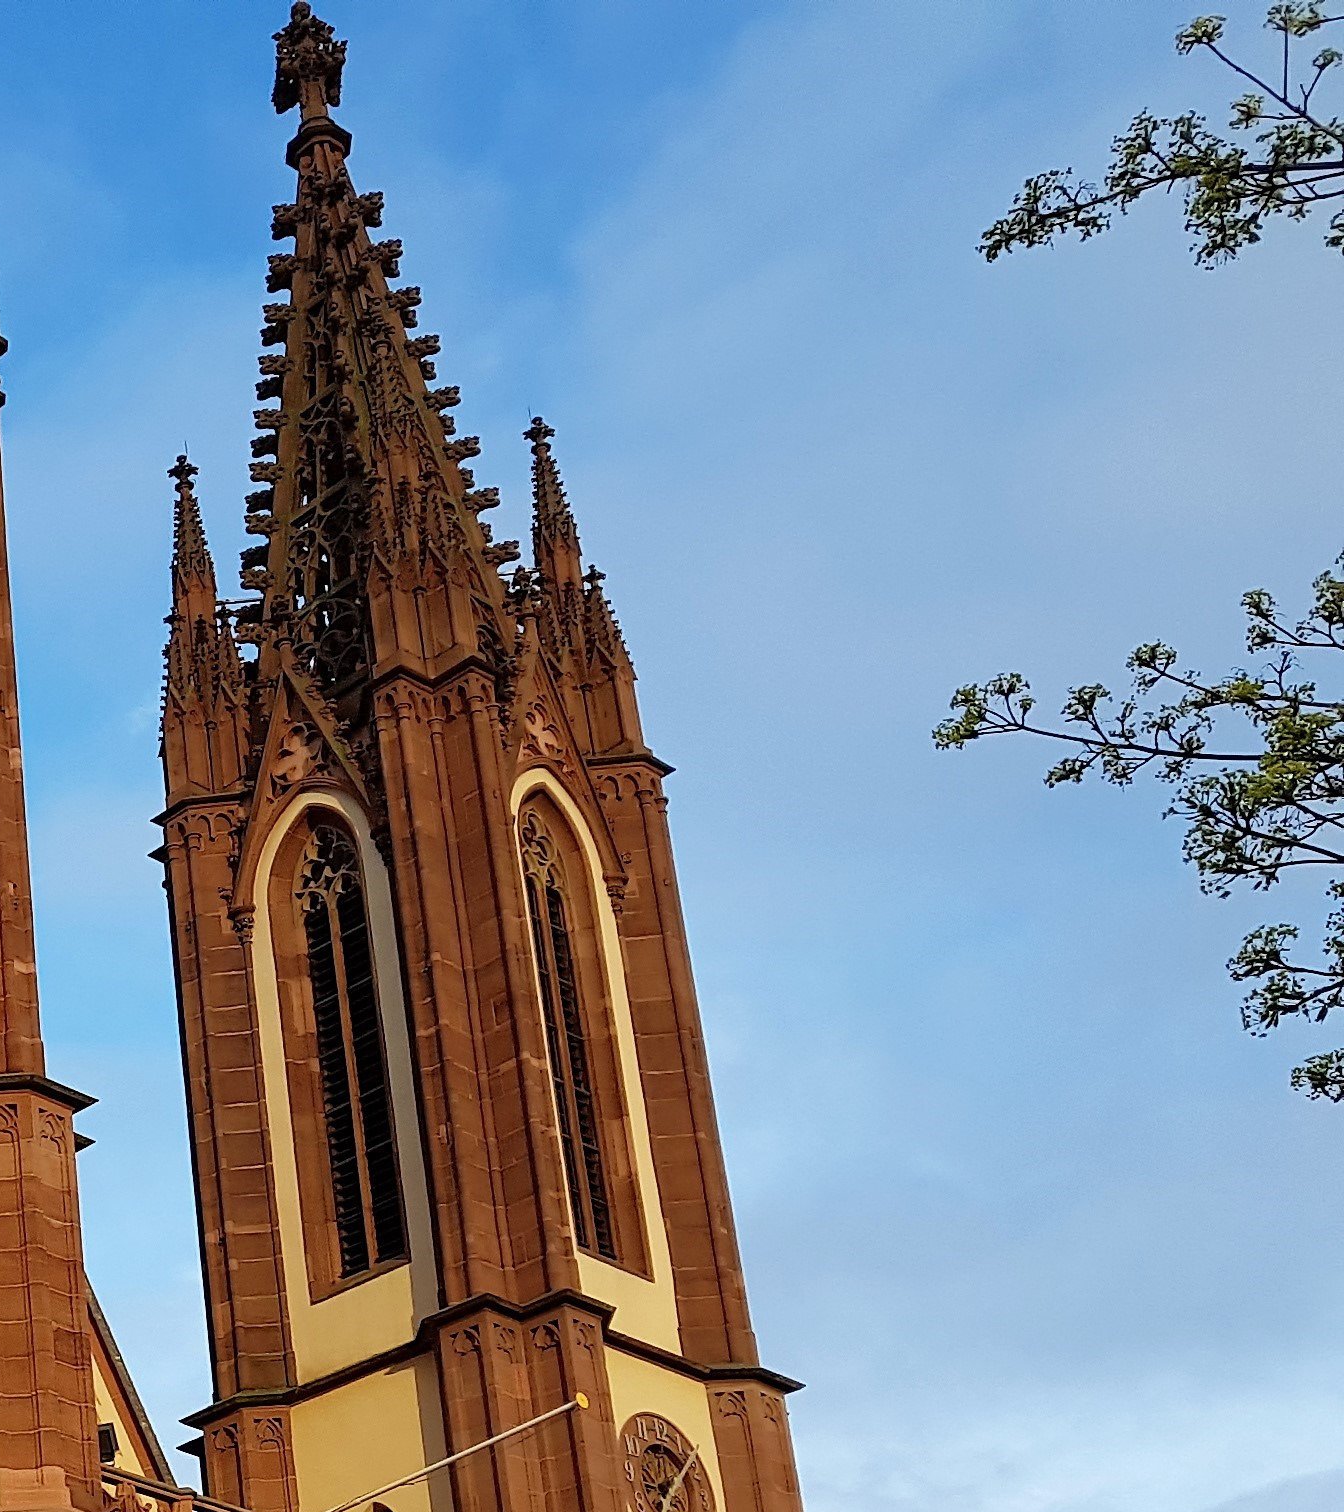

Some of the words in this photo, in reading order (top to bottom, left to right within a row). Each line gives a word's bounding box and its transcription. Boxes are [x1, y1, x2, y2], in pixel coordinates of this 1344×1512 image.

[636, 1417, 648, 1442] 11
[653, 1418, 667, 1443] 12
[625, 1433, 640, 1457] 10
[675, 1434, 683, 1455] 1
[625, 1460, 634, 1482] 9
[635, 1491, 646, 1512] 8
[700, 1489, 710, 1511] 3
